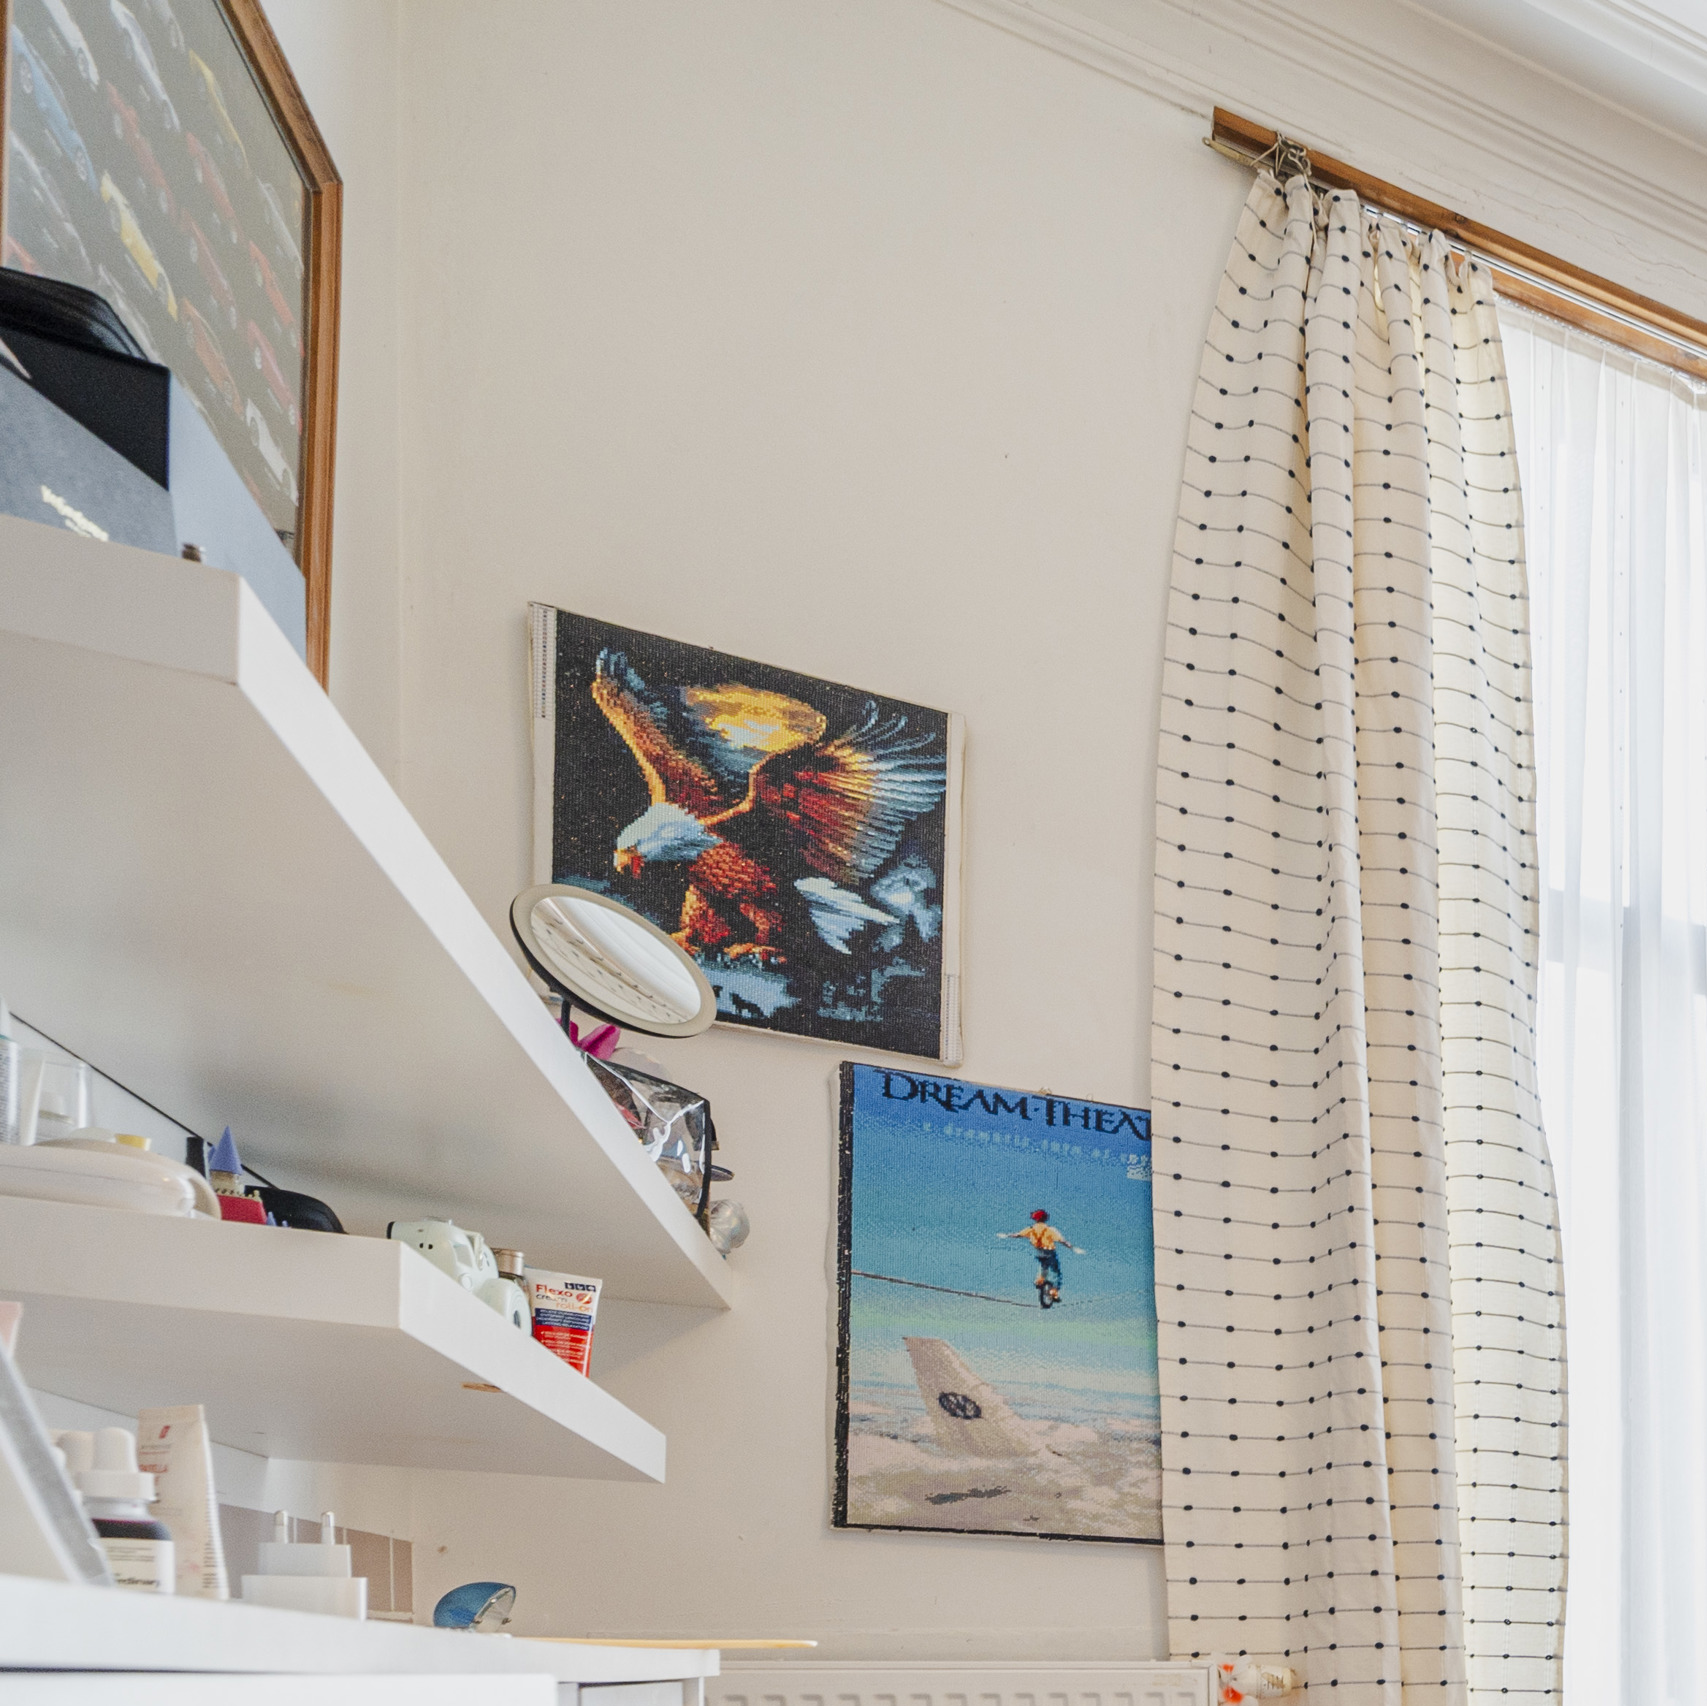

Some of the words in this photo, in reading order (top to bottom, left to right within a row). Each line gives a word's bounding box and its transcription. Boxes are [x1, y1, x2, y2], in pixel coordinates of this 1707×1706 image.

[873, 1068, 1032, 1121] DREAM
[536, 1284, 573, 1298] Flexo
[556, 1302, 593, 1313] roll-on
